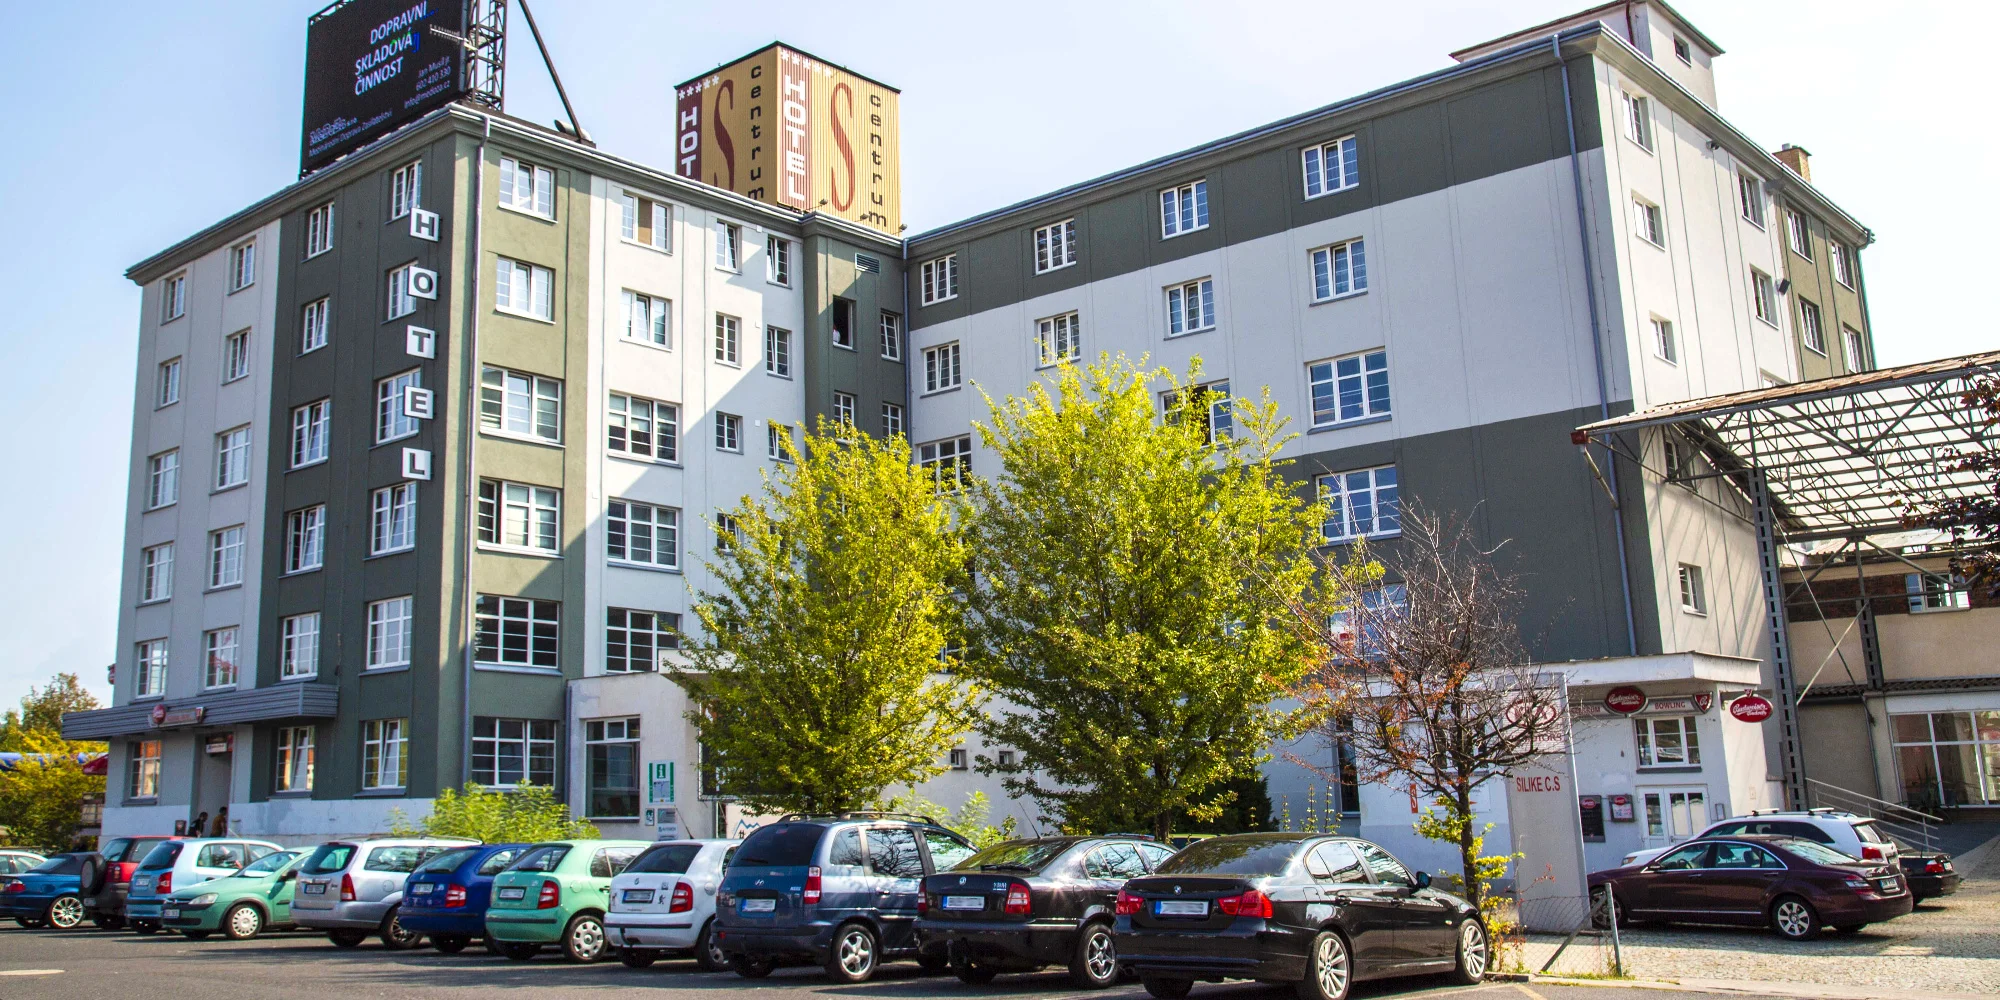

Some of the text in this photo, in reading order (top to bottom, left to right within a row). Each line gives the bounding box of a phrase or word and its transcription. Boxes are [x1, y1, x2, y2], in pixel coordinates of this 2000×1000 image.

[355, 27, 412, 75] SKLADOVÁ
[355, 57, 404, 96] ČINNOST
[748, 65, 764, 200] centrum
[783, 74, 807, 200] HOTEL
[830, 82, 856, 212] S
[868, 94, 887, 227] centrum
[408, 211, 435, 477] HOTEL
[1654, 701, 1686, 710] BOWLING
[1732, 703, 1768, 716] Budweiser
[1516, 775, 1561, 793] SILIKE C.S
